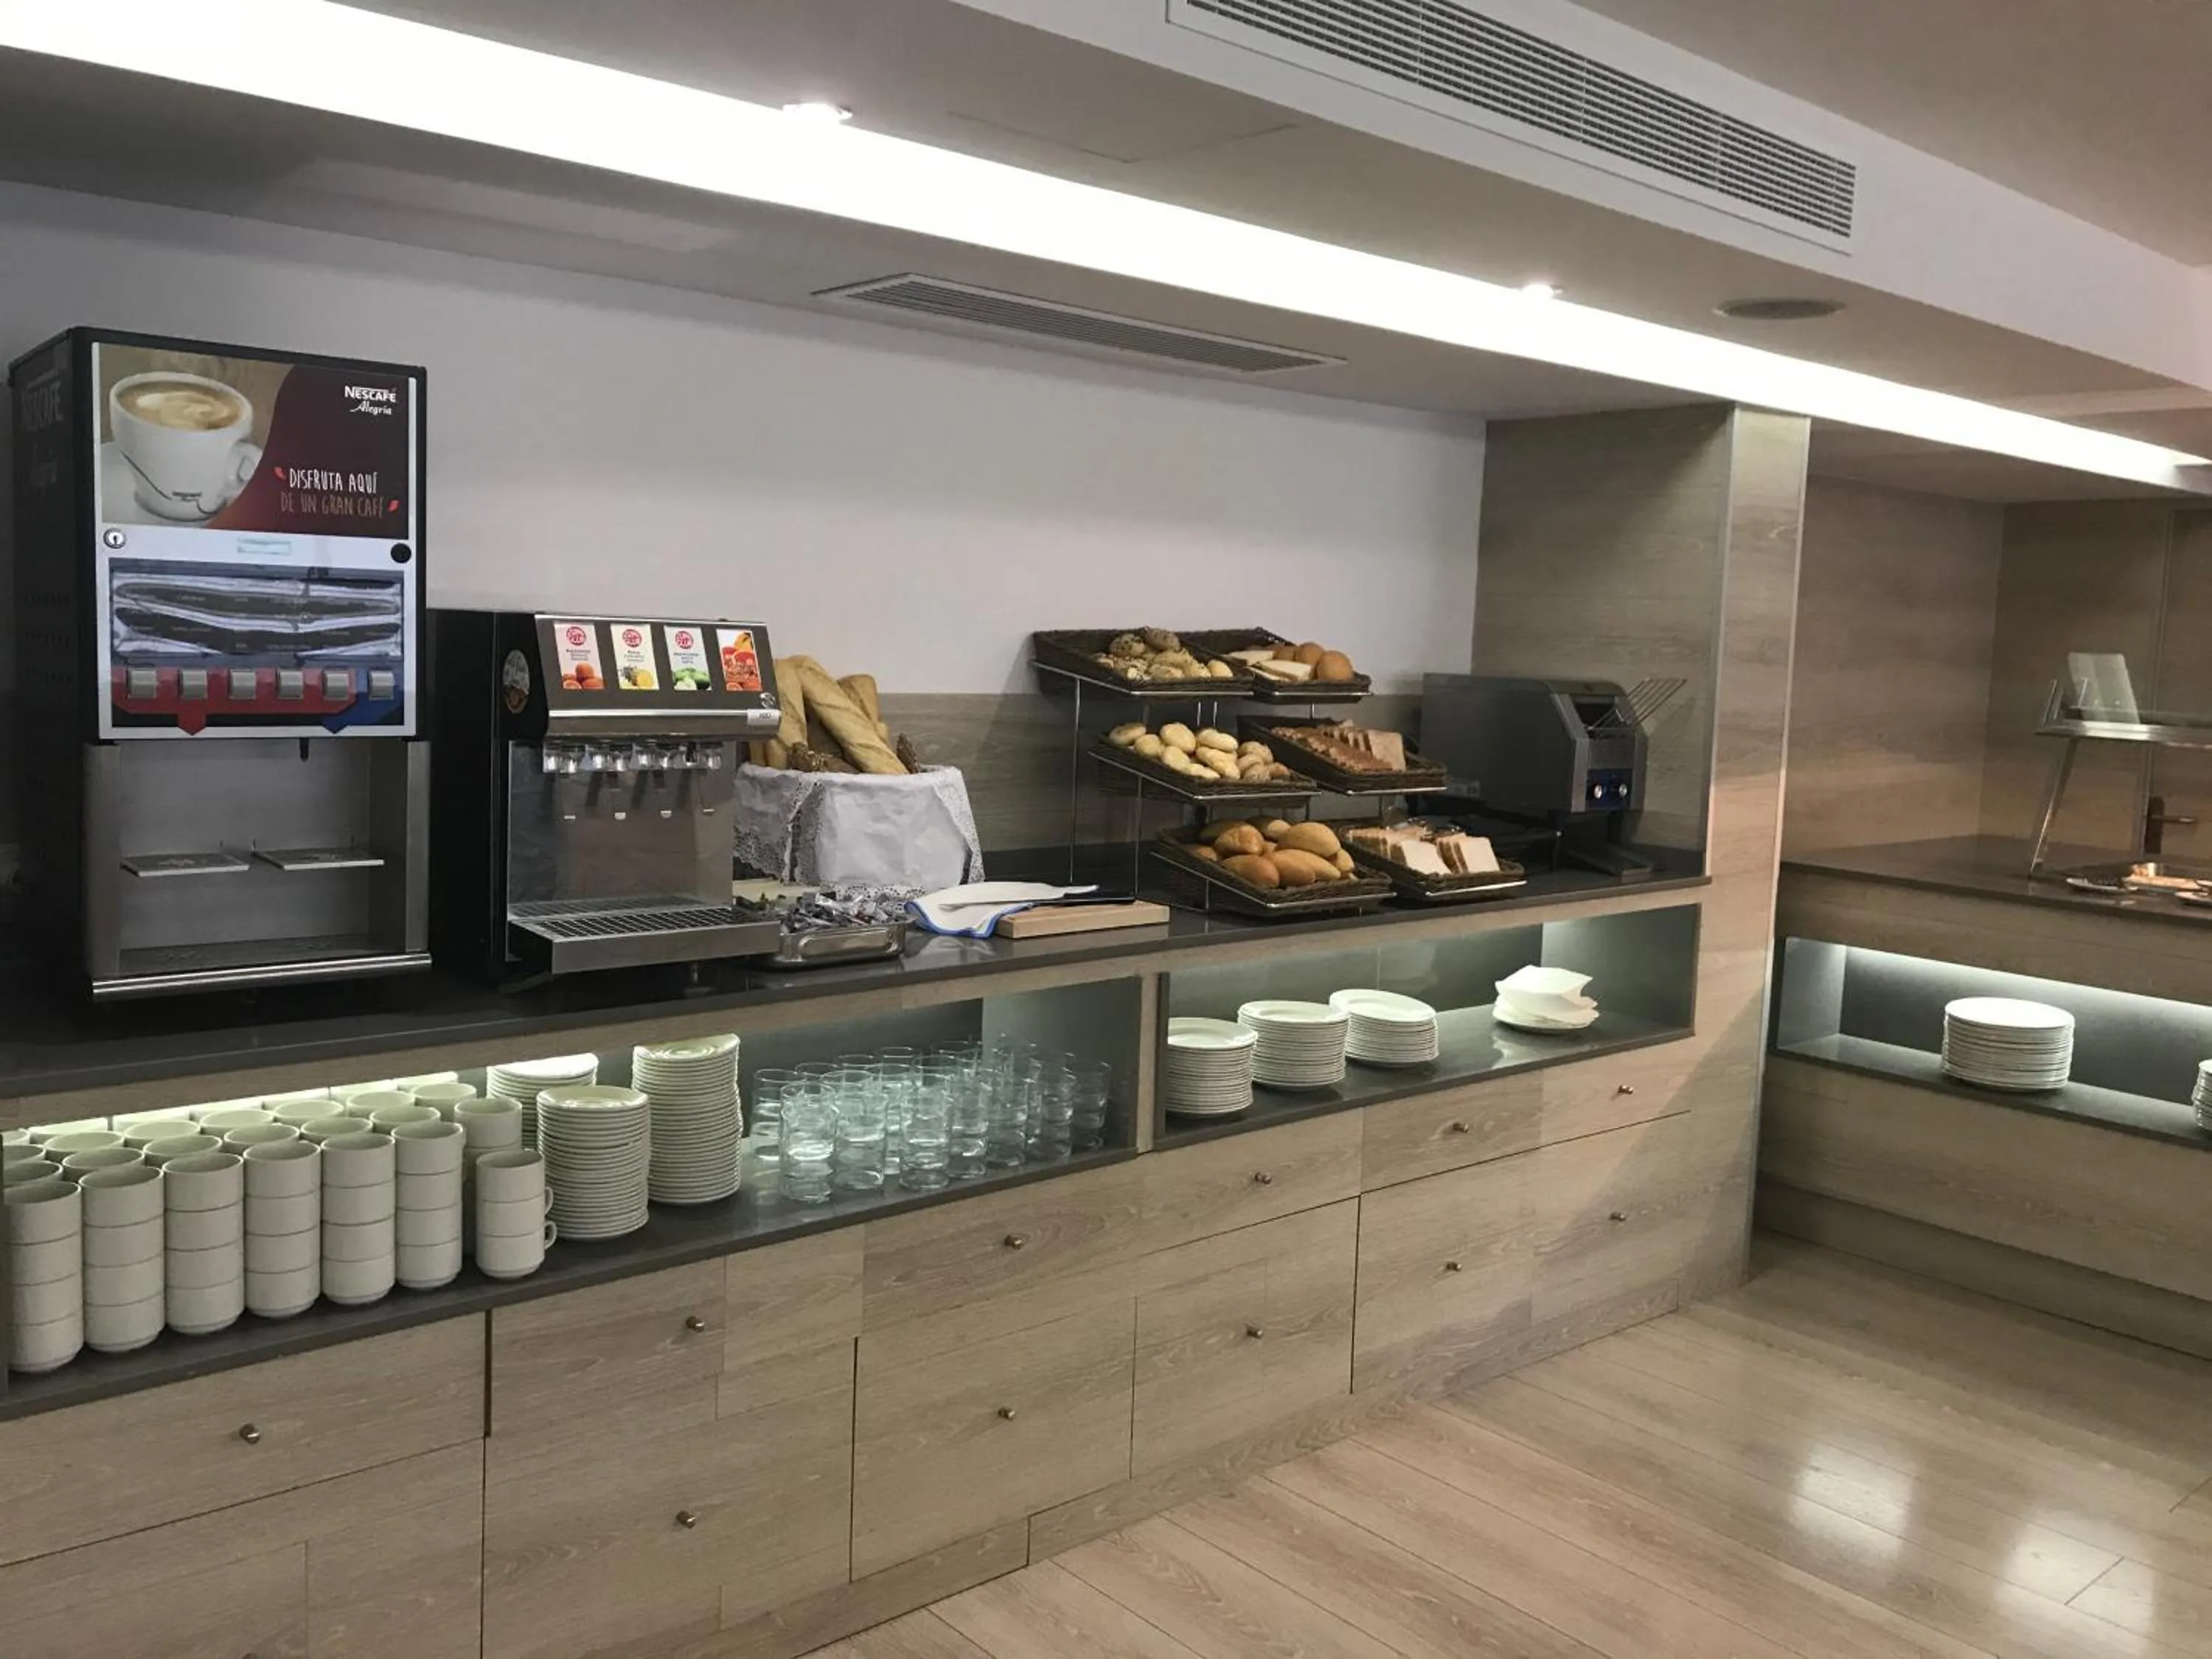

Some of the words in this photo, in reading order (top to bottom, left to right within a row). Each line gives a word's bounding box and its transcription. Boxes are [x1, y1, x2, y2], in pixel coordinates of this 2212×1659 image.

[289, 467, 343, 492] DISFRUTA
[280, 492, 294, 512] DE
[300, 493, 317, 514] UN
[321, 495, 354, 515] GRAN
